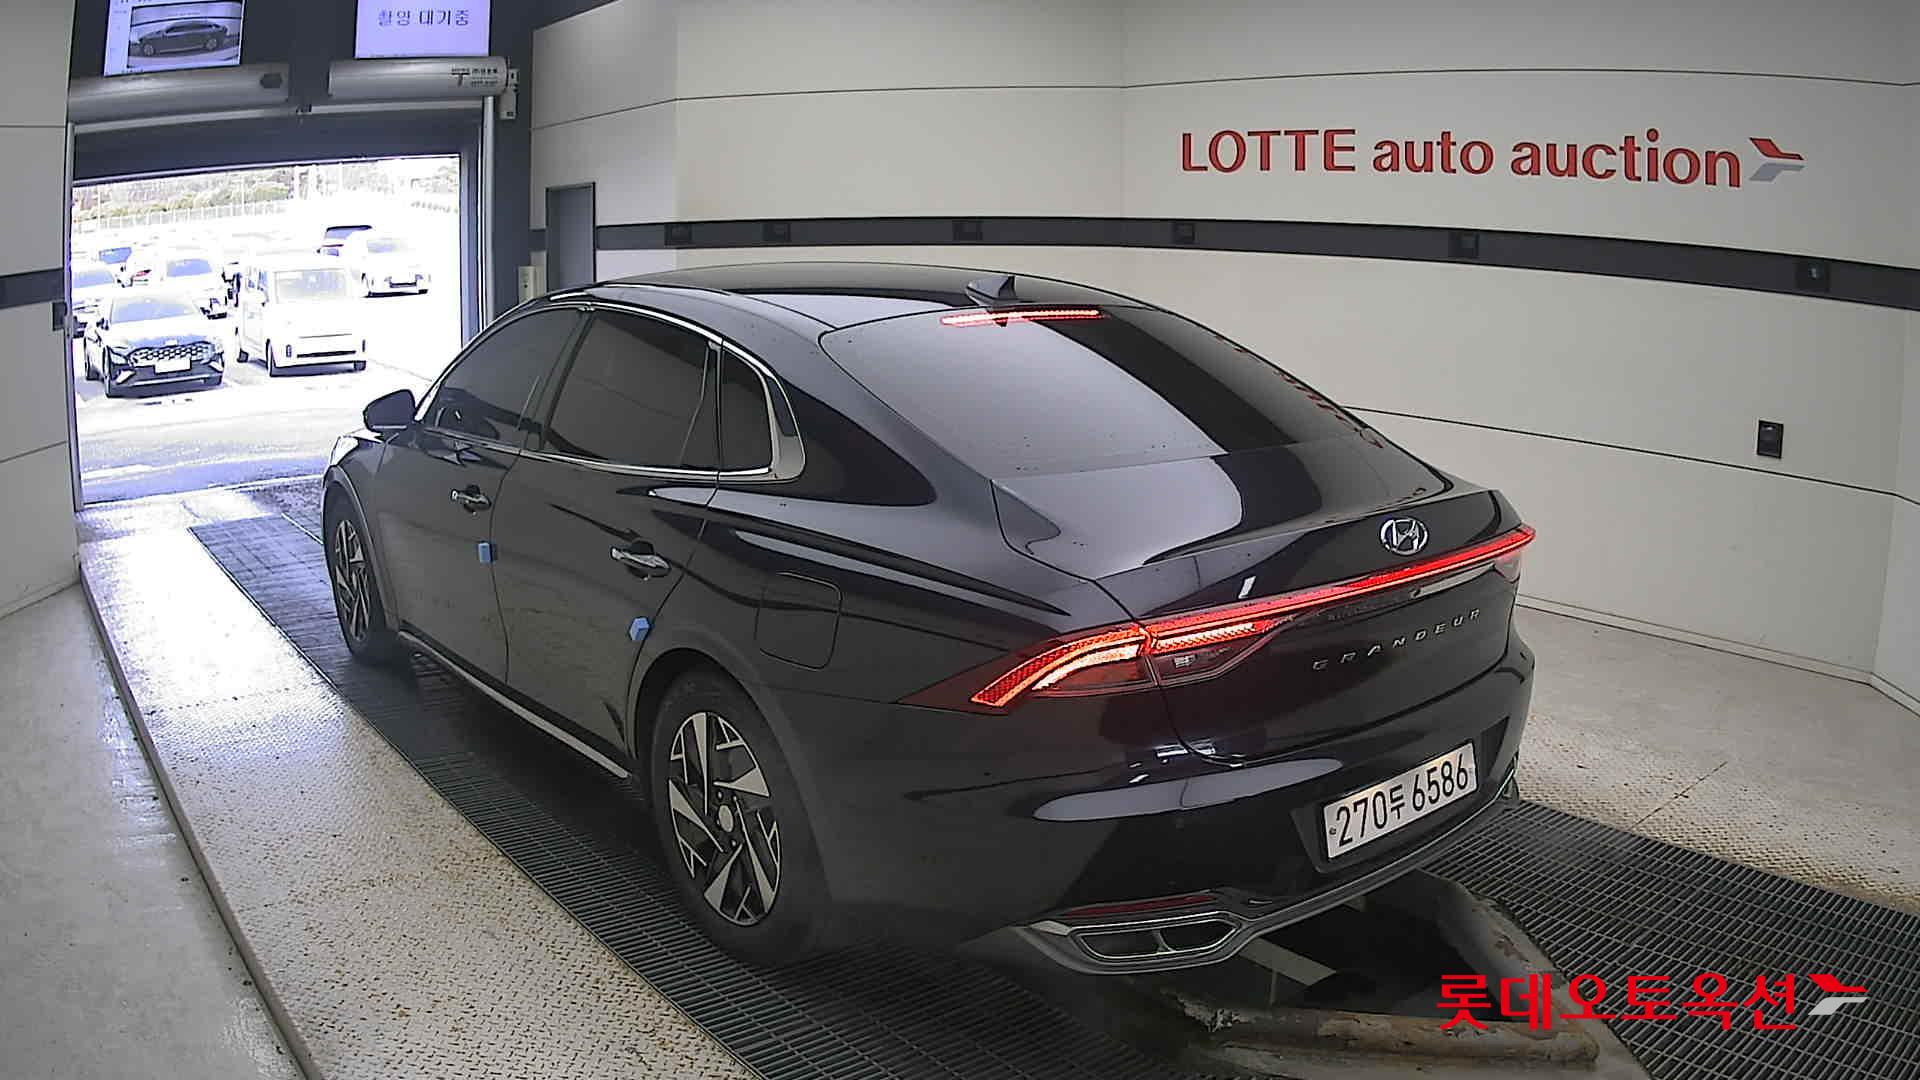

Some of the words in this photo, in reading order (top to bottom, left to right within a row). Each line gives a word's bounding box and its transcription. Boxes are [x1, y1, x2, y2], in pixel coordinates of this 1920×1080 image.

[1180, 128, 1357, 173] LOTTE
[1371, 129, 1494, 175] auto
[1509, 127, 1742, 188] auction
[1312, 608, 1480, 670] GRANDEUR
[1336, 784, 1405, 848] 270두
[1412, 753, 1469, 812] 6586
